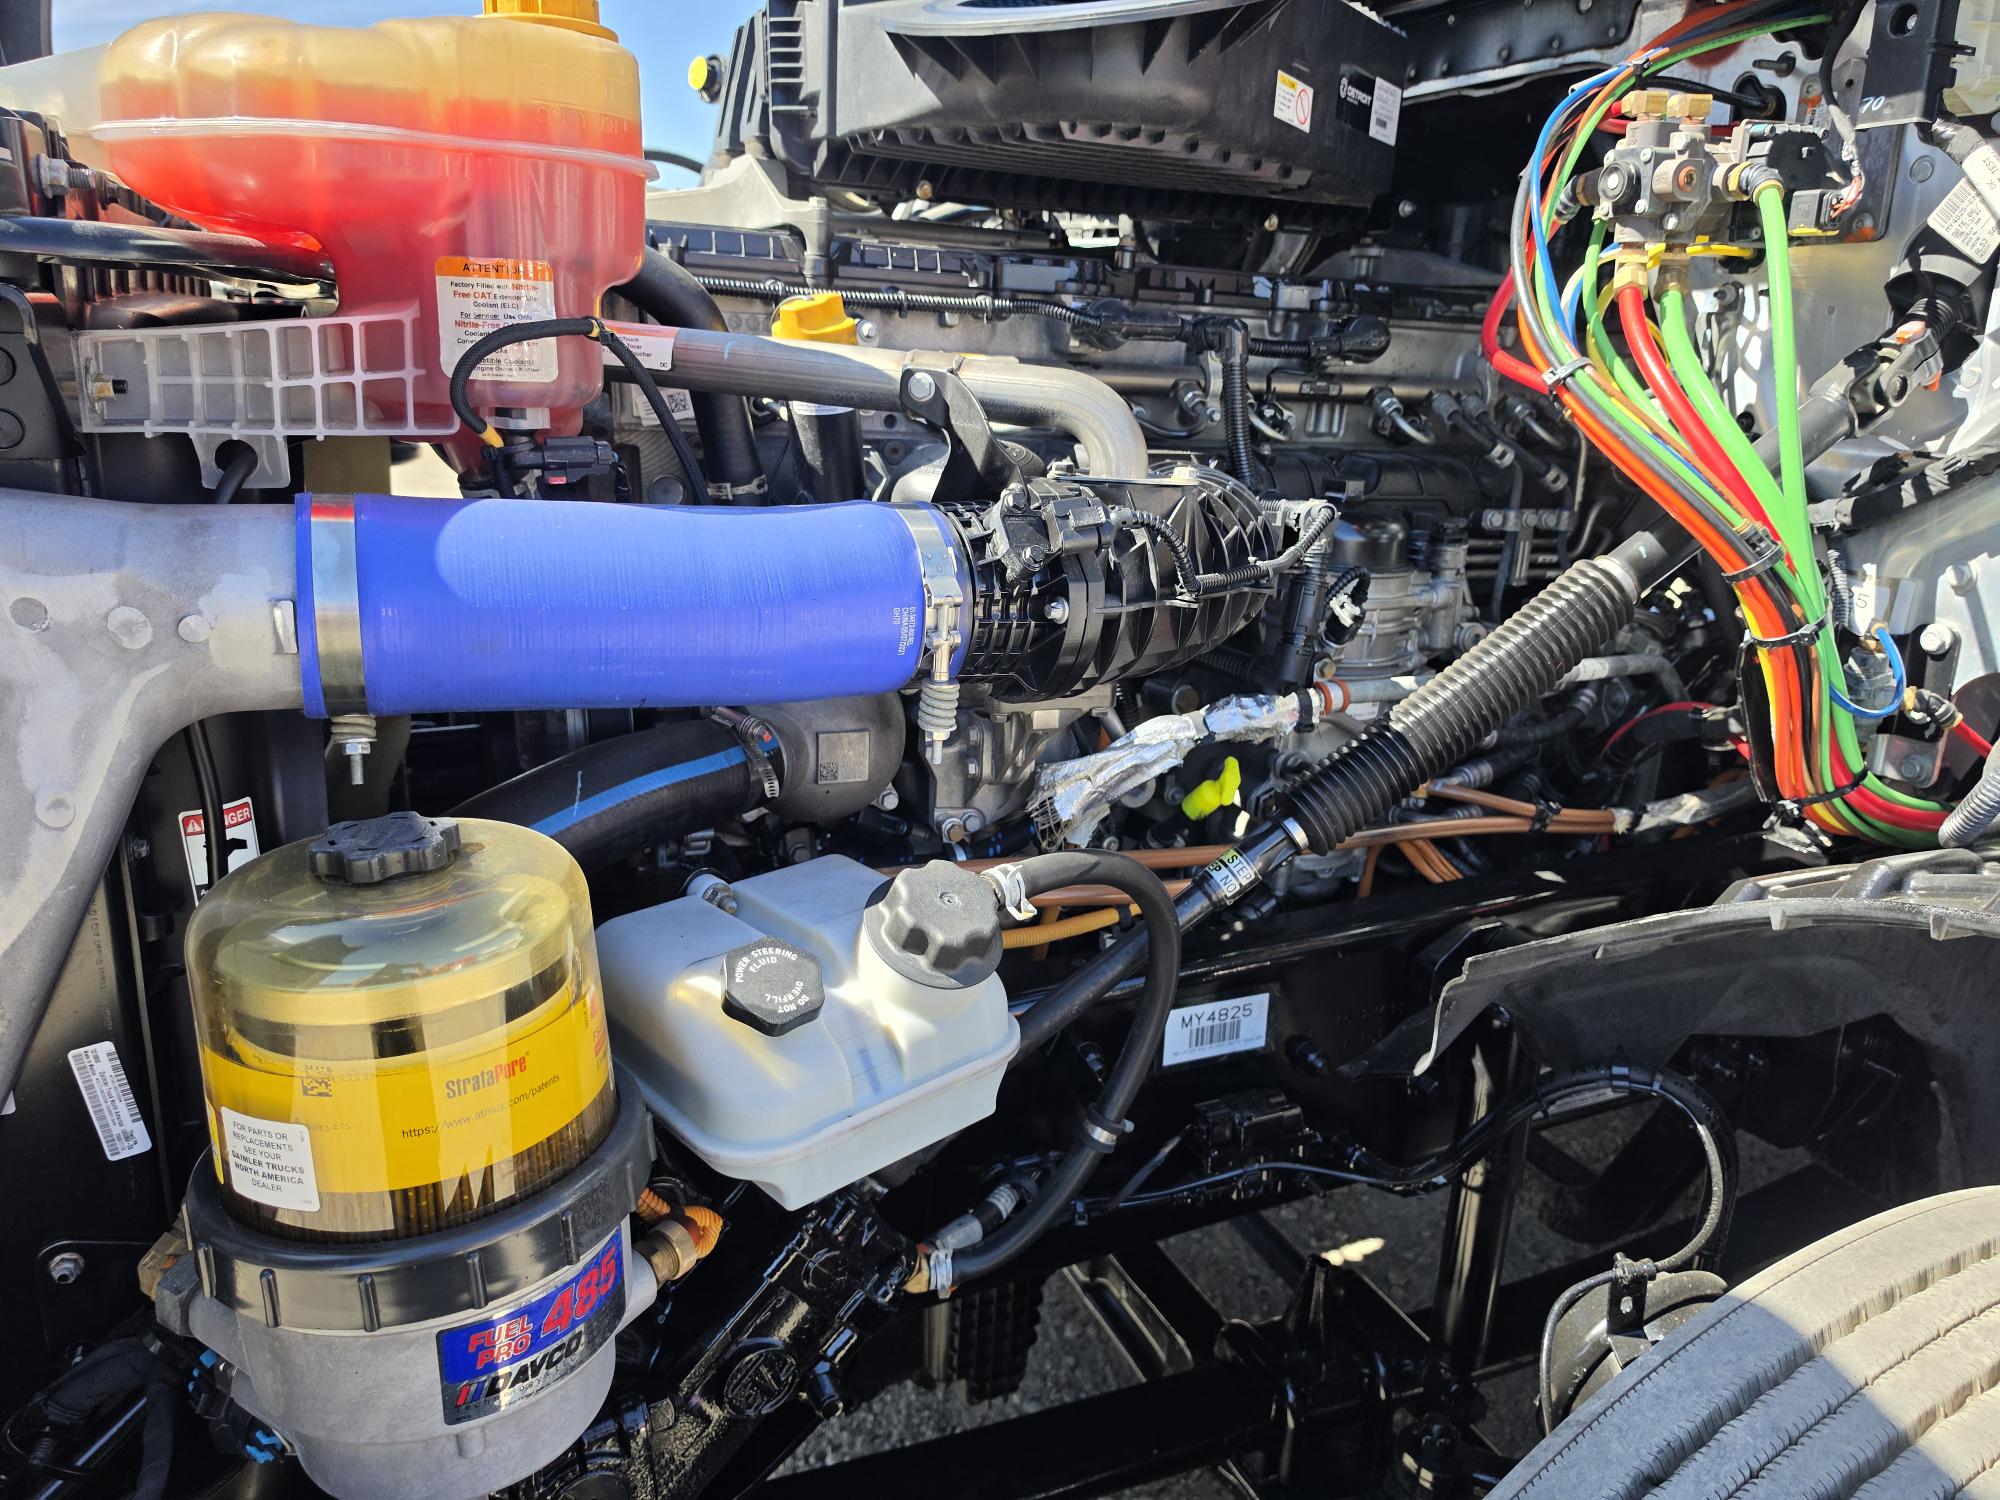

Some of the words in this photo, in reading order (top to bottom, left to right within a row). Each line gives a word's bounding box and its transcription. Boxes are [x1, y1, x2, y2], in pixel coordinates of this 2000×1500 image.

[450, 281, 475, 290] Factory
[453, 290, 472, 298] Free
[1227, 855, 1252, 880] STEP
[1220, 874, 1236, 892] NO
[735, 956, 751, 983] POWER
[751, 947, 798, 960] STEERING
[749, 956, 777, 972] FLUID
[764, 980, 804, 1004] OVERFILL
[798, 994, 810, 1006] DO
[777, 1003, 797, 1014] NOT
[1181, 1003, 1253, 1029] MY4825
[445, 1055, 527, 1099] StrataPore
[402, 1074, 560, 1138] https://www.atmus.com/patents
[232, 1130, 294, 1152] REPLACEMENTS
[233, 1121, 246, 1132] FOR
[248, 1126, 273, 1139] PARTS
[275, 1132, 288, 1141] OR
[231, 1149, 264, 1168] DAIMLER
[265, 1161, 305, 1174] TRUCKS
[243, 1145, 257, 1156] SEE
[259, 1150, 282, 1161] YOUR
[234, 1160, 260, 1177] NORTH
[261, 1171, 304, 1185] AMERICA
[251, 1178, 283, 1192] DEALER
[468, 1314, 534, 1352] FUEL
[540, 1247, 616, 1338] 485
[476, 1334, 531, 1369] PRO
[486, 1330, 583, 1398] DAVCO
